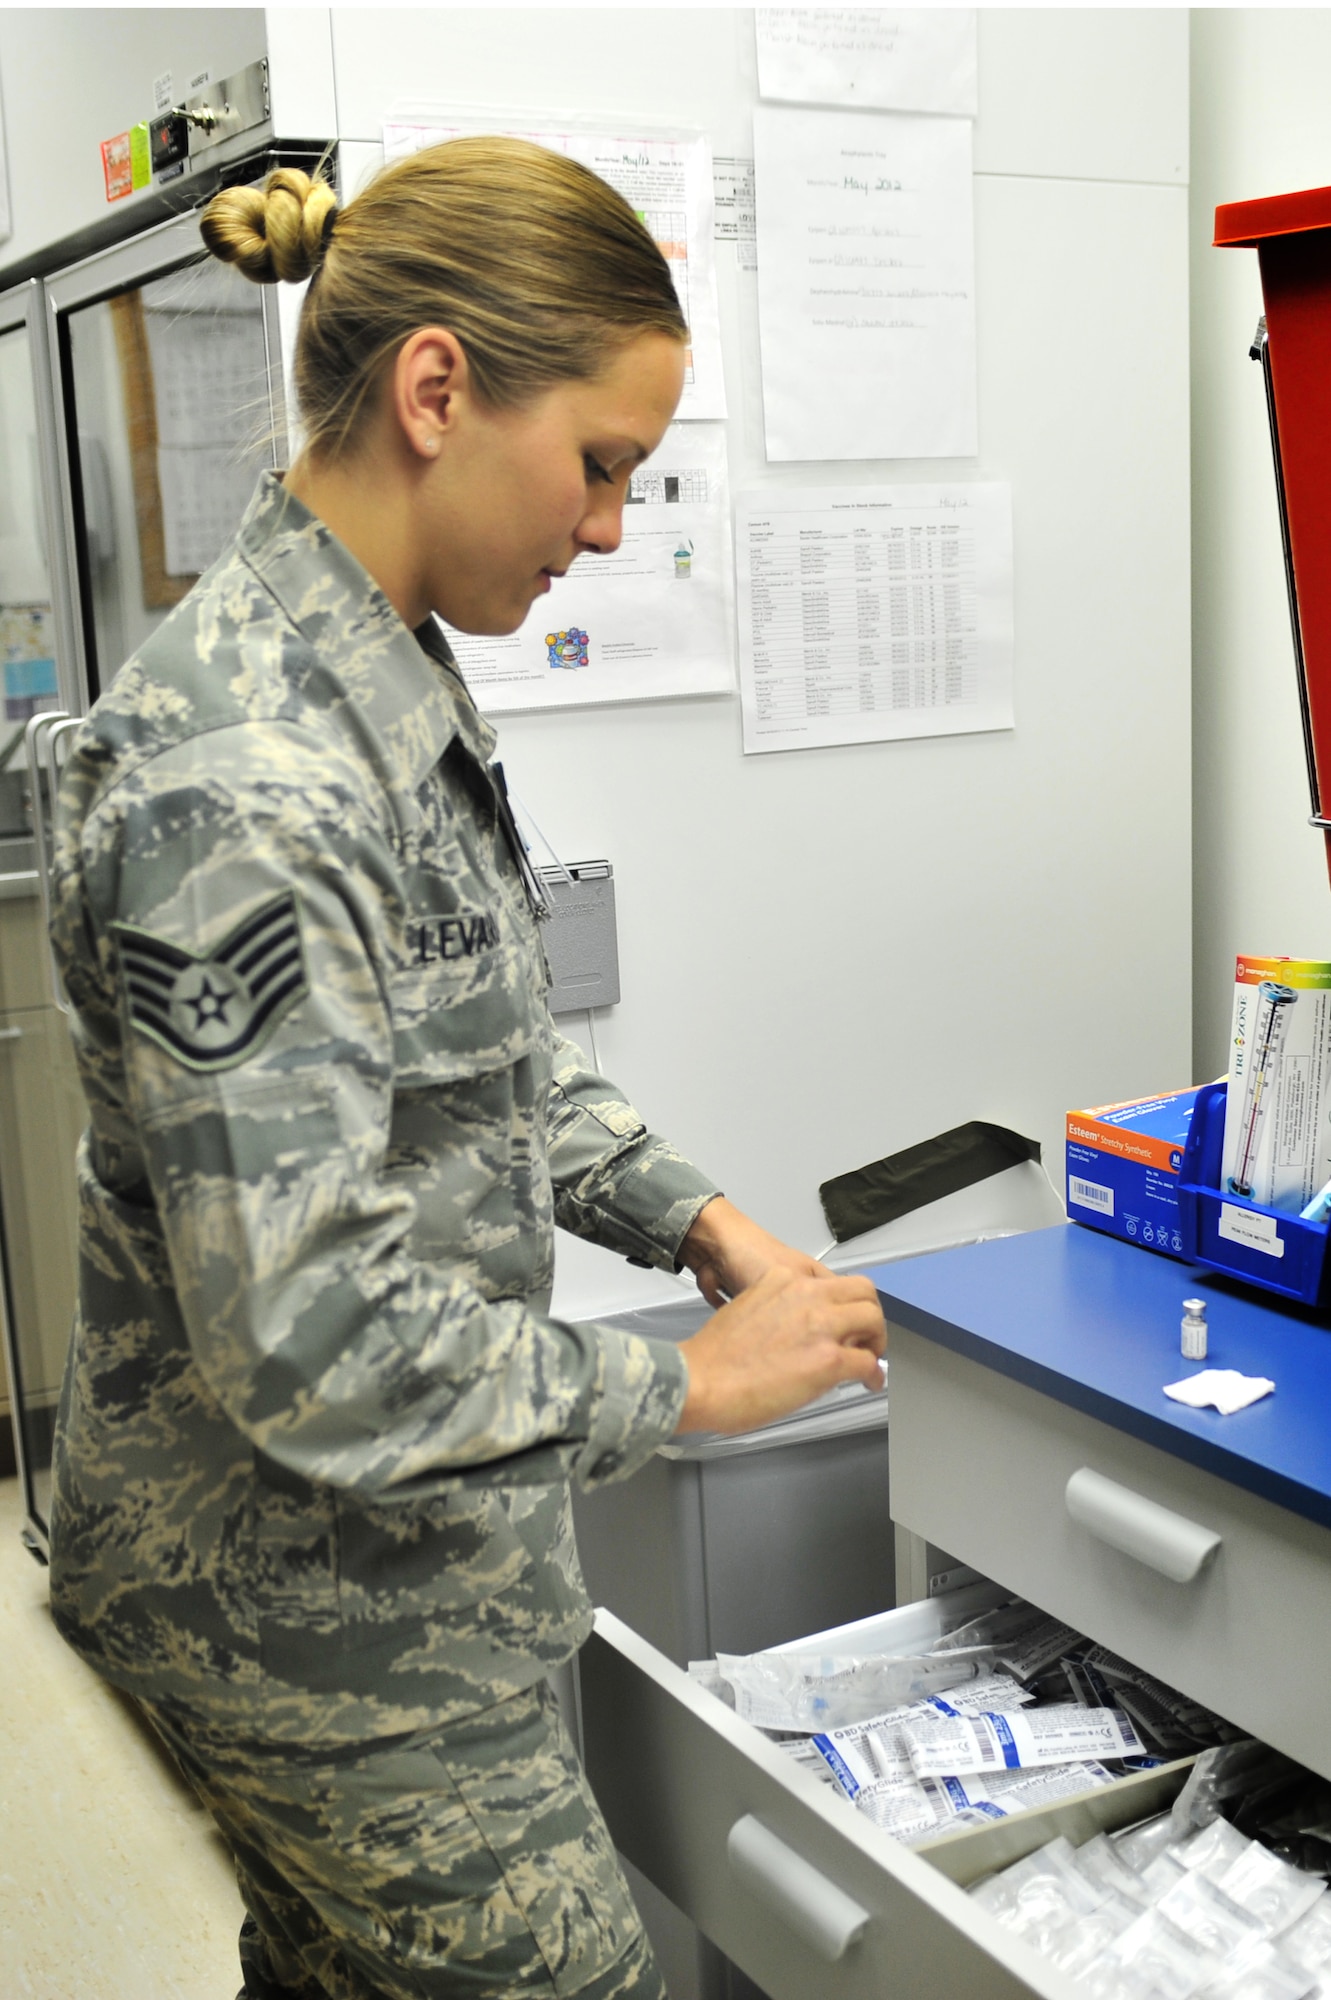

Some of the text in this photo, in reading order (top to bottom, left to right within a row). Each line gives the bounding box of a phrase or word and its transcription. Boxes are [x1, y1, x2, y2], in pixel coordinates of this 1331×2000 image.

[843, 176, 902, 197] May 2012
[1101, 1135, 1124, 1152] Stretchy
[1124, 1142, 1152, 1159] Synthetic
[1173, 1154, 1181, 1165] M
[1242, 1230, 1253, 1238] FLOW
[1254, 1235, 1270, 1245] METERS
[844, 1727, 858, 1738] BD
